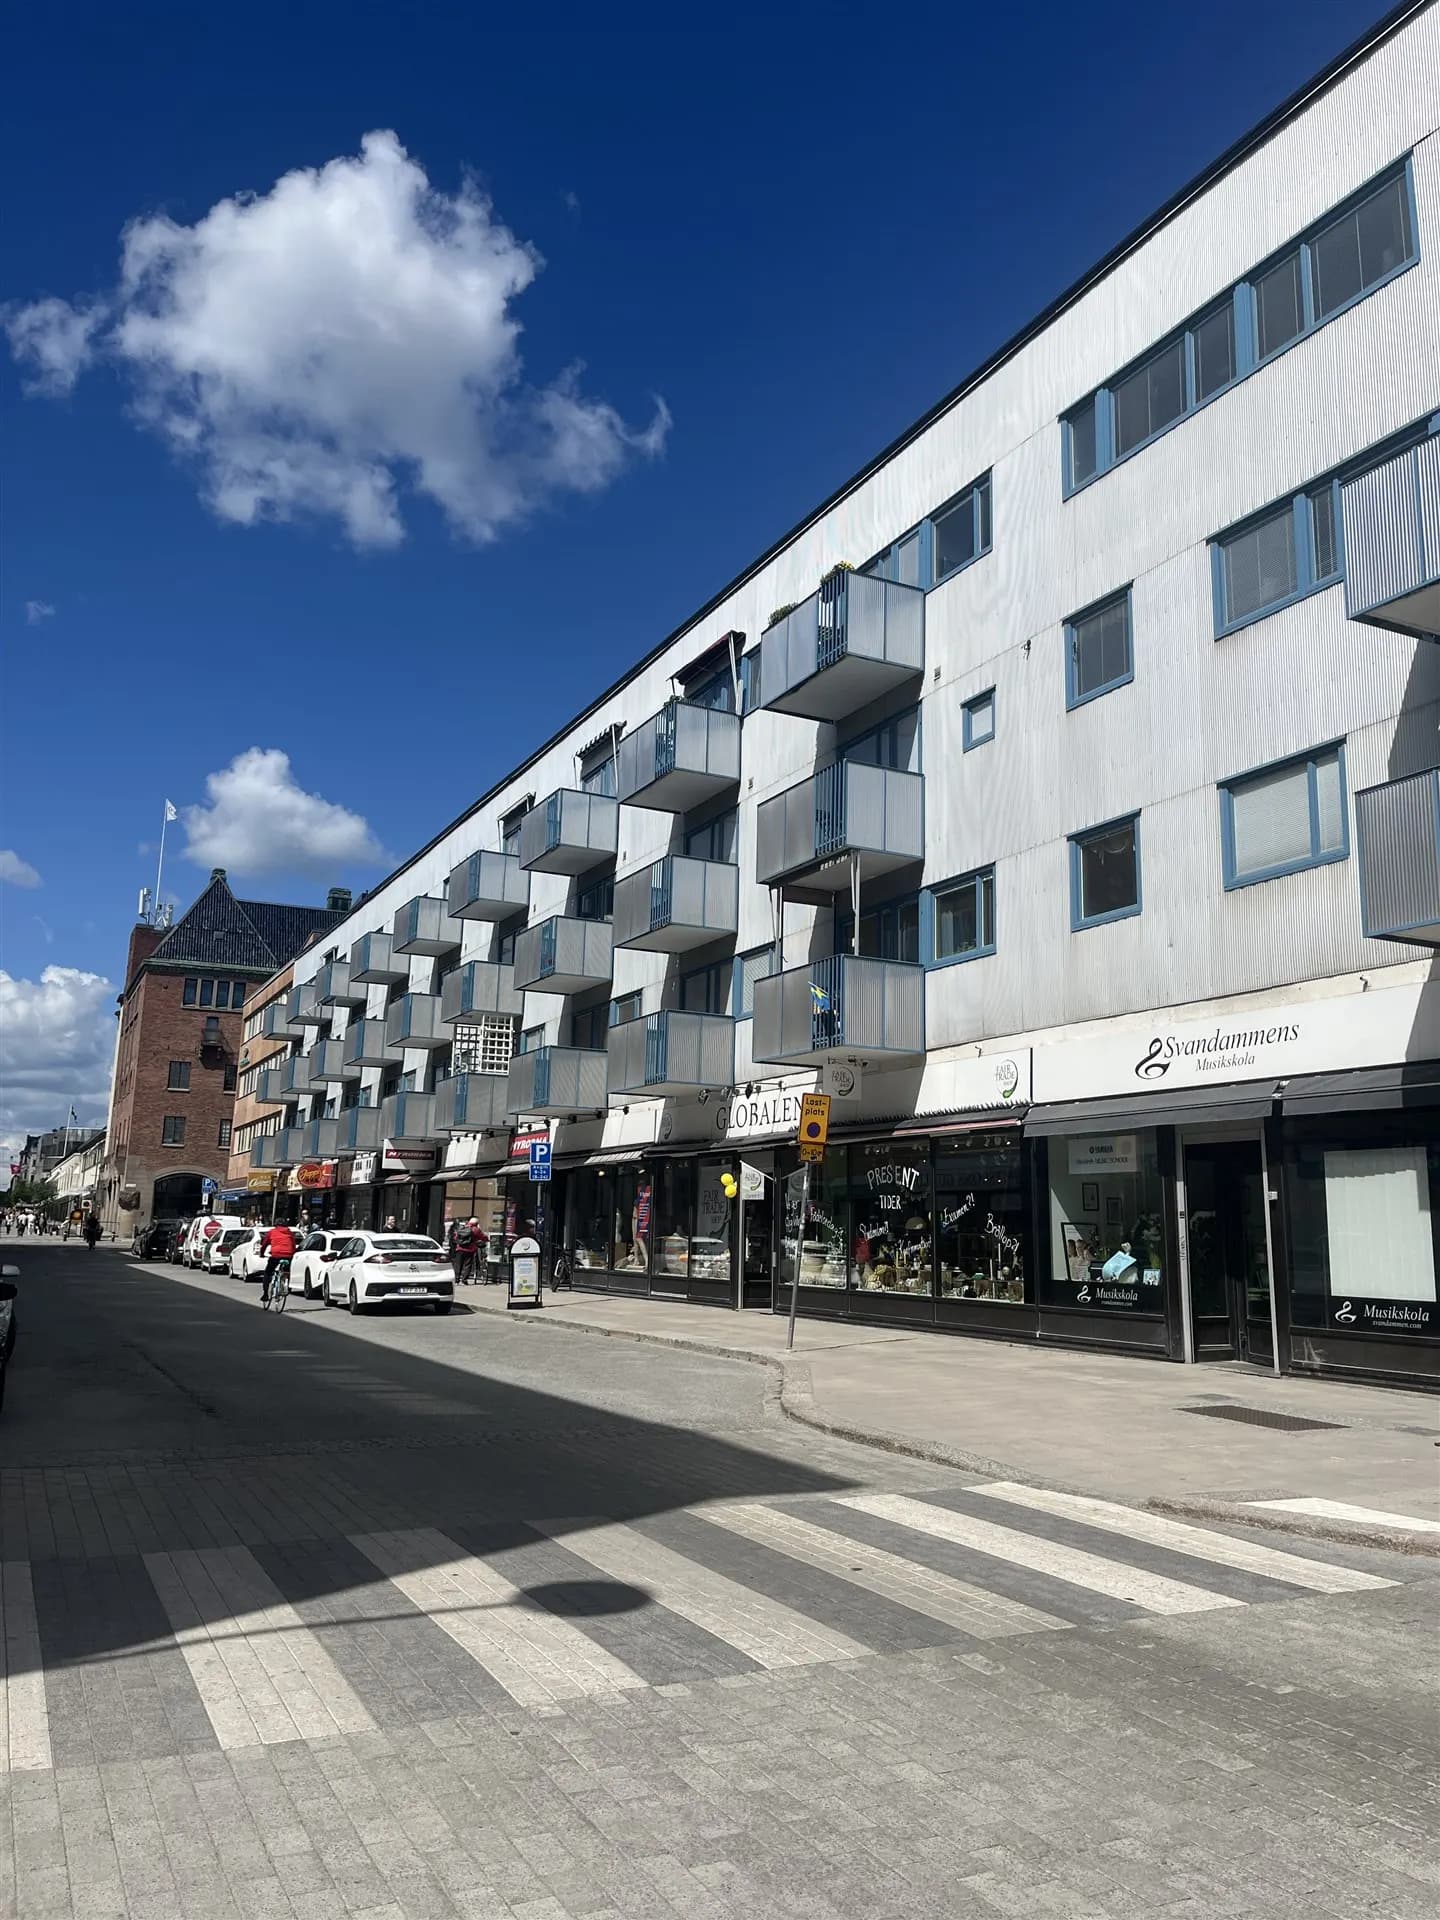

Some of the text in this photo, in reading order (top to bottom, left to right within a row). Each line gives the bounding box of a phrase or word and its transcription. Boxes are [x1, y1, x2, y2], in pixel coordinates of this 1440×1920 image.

[1163, 1023, 1300, 1059] Svandammens
[1195, 1051, 1256, 1072] Musikskola
[805, 1097, 827, 1107] Last-
[716, 1096, 802, 1130] GLOBALEN
[804, 1107, 825, 1117] plats
[536, 1144, 548, 1162] P
[866, 1164, 920, 1191] PRESENT
[879, 1194, 902, 1210] TIDER
[1095, 1287, 1138, 1301] Musikskola
[1363, 1303, 1430, 1322] Musikskola
